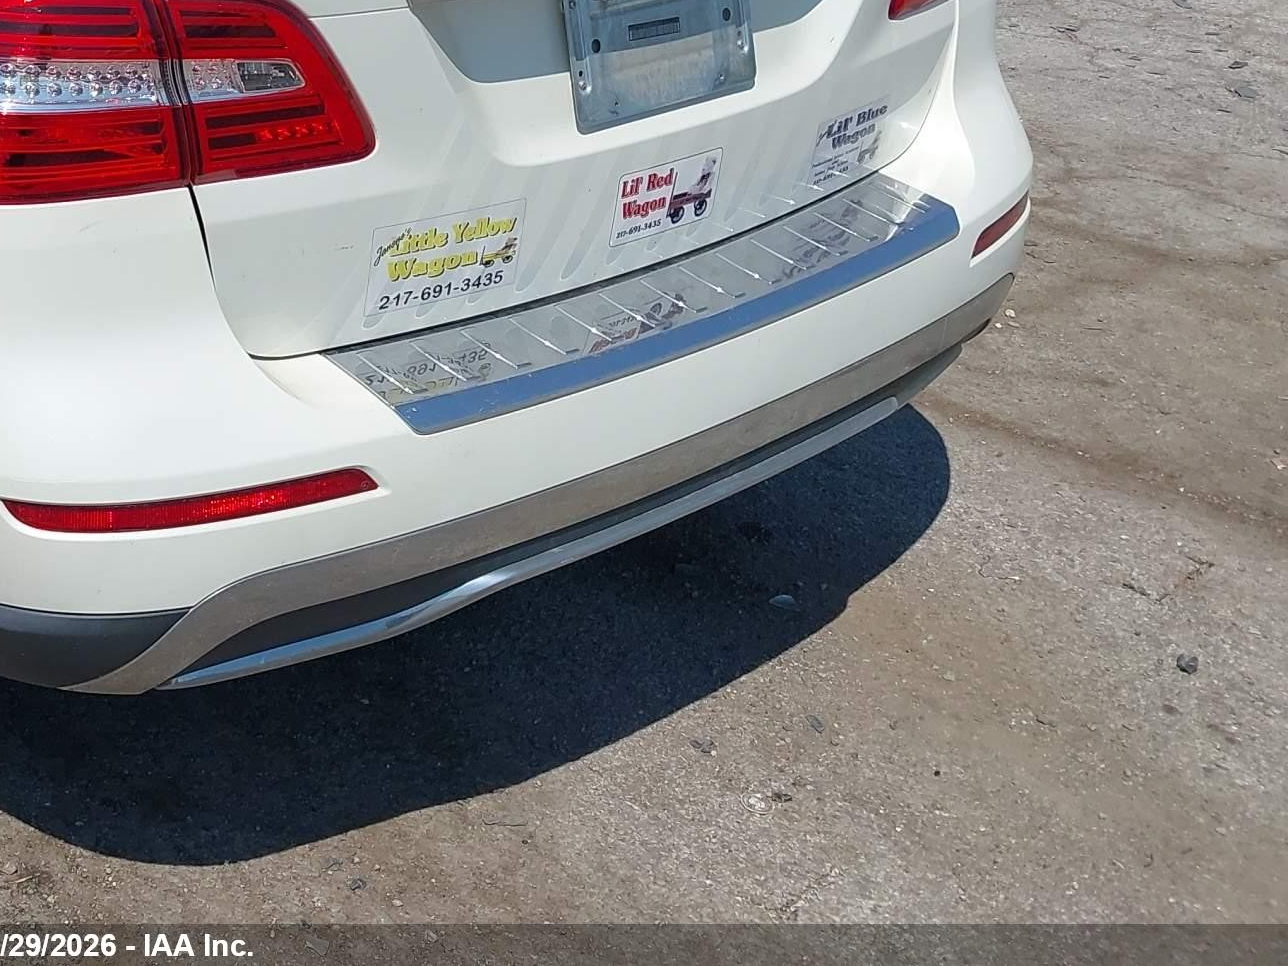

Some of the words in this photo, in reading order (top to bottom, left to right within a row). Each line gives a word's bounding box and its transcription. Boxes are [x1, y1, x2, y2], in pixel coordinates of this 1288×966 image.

[856, 105, 888, 127] Blue
[647, 167, 675, 192] Red
[622, 197, 667, 220] Wagon
[388, 228, 449, 256] Little
[452, 217, 517, 244] Yellow
[616, 219, 662, 239] 217-691-3435
[387, 250, 478, 282] Wagon
[378, 270, 504, 310] 217-691-3435
